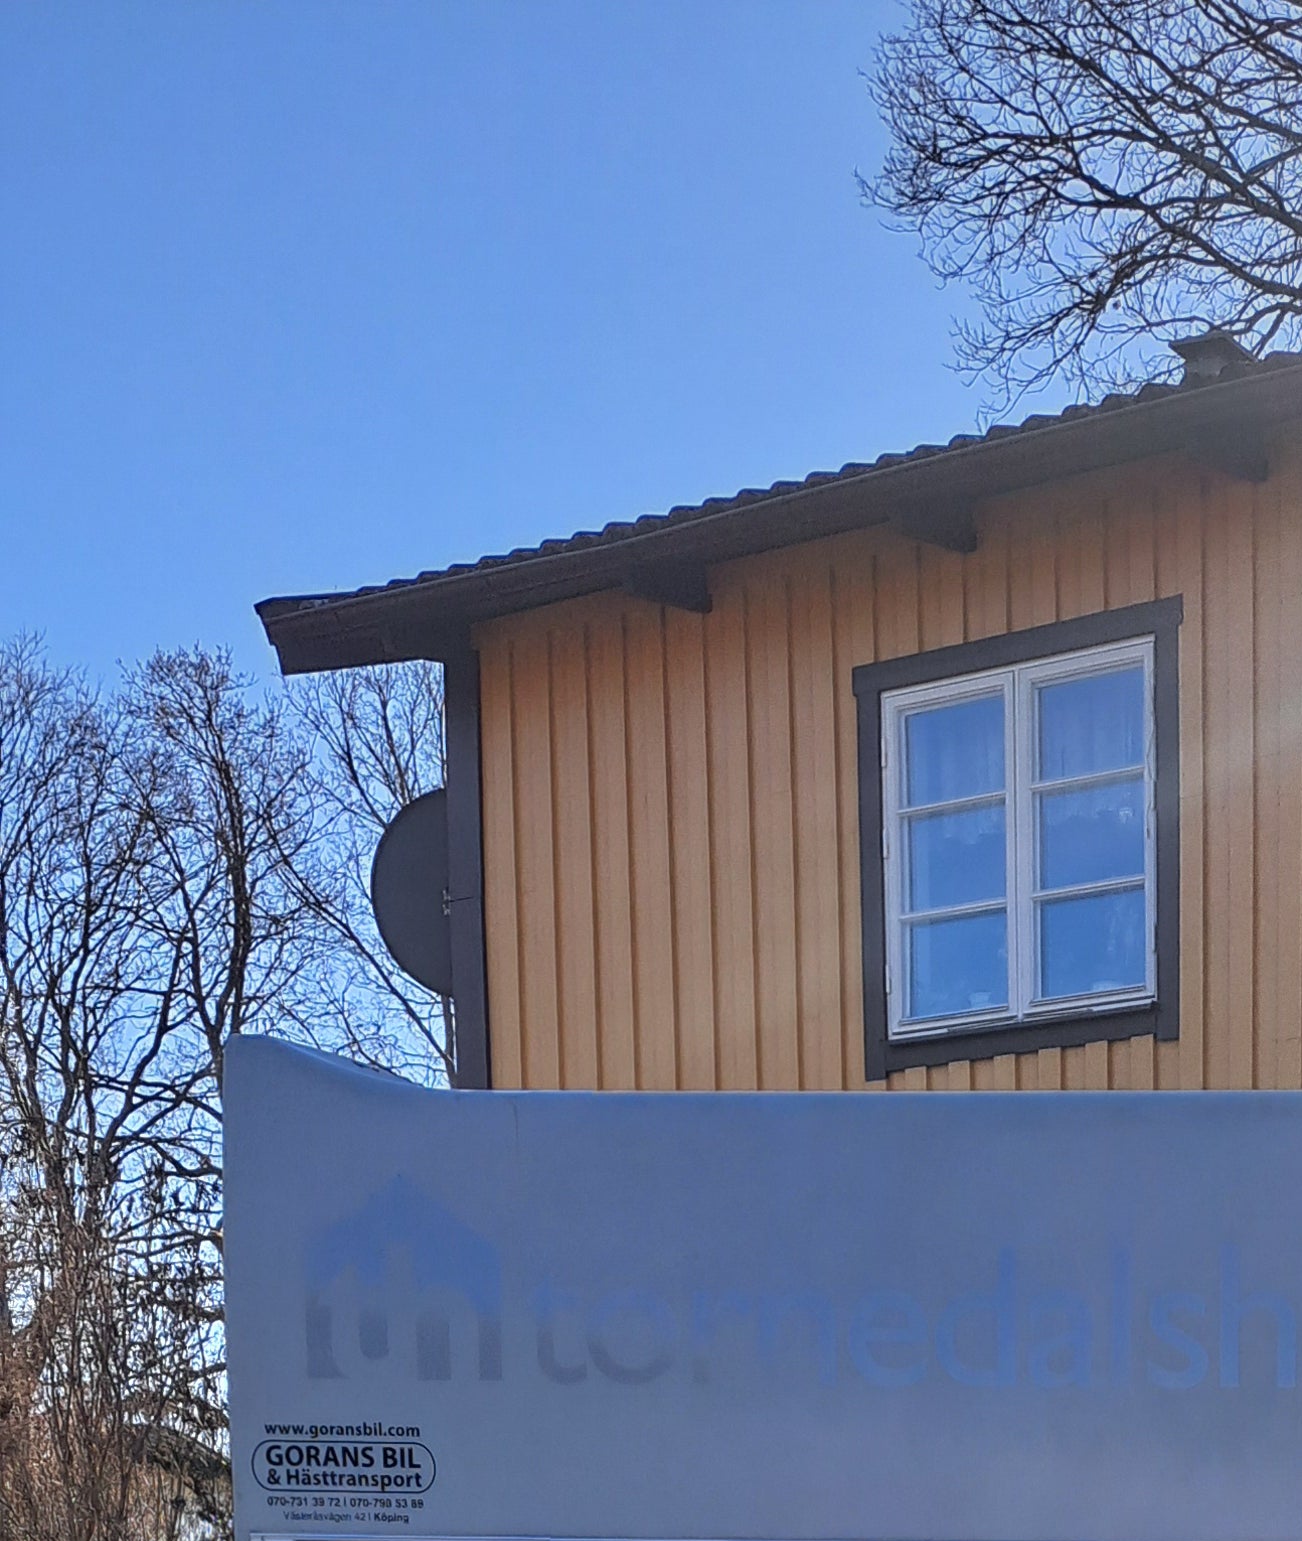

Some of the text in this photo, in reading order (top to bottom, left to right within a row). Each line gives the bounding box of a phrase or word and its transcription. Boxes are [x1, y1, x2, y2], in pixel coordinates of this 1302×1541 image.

[264, 1422, 421, 1438] www.goransbil.com
[265, 1444, 422, 1469] GORANS BIL
[267, 1468, 423, 1492] & Hästtransport
